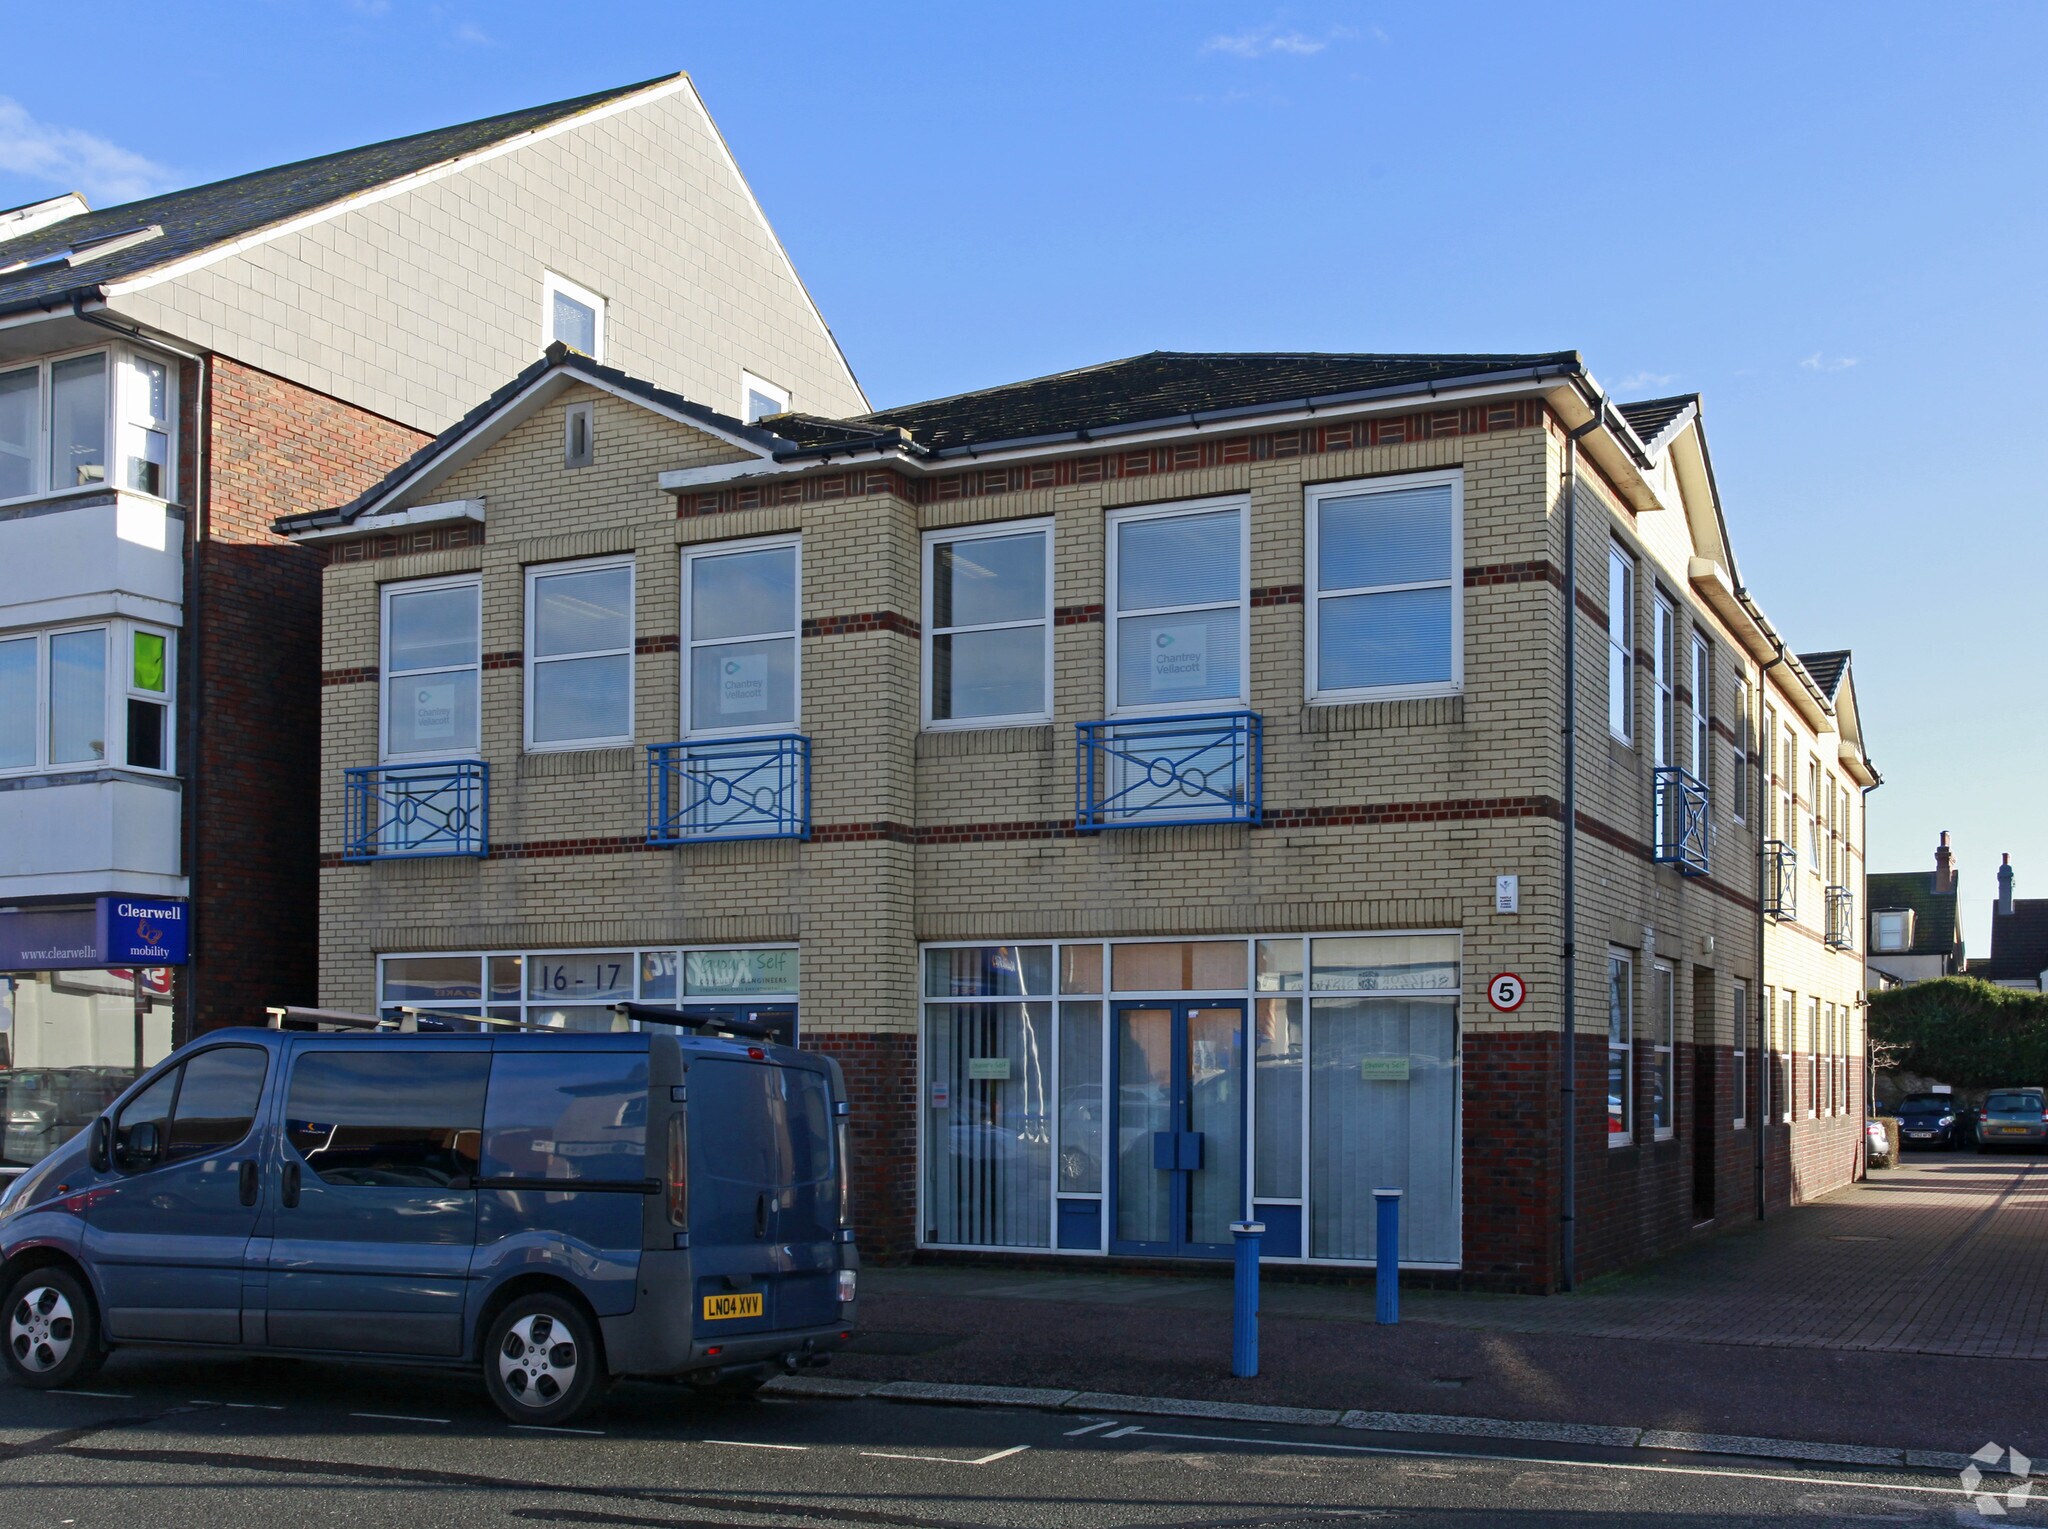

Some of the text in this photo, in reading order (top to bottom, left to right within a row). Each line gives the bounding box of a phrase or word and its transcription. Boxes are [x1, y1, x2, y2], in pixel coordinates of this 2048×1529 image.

[1156, 653, 1201, 664] Chantrey
[1156, 663, 1200, 674] Vellacott
[118, 904, 181, 920] Clearwell
[130, 945, 170, 959] mobility
[756, 952, 787, 971] Self
[544, 965, 567, 991] 16
[597, 964, 621, 990] 17
[1498, 982, 1515, 1002] 5
[708, 1297, 737, 1316] LN04
